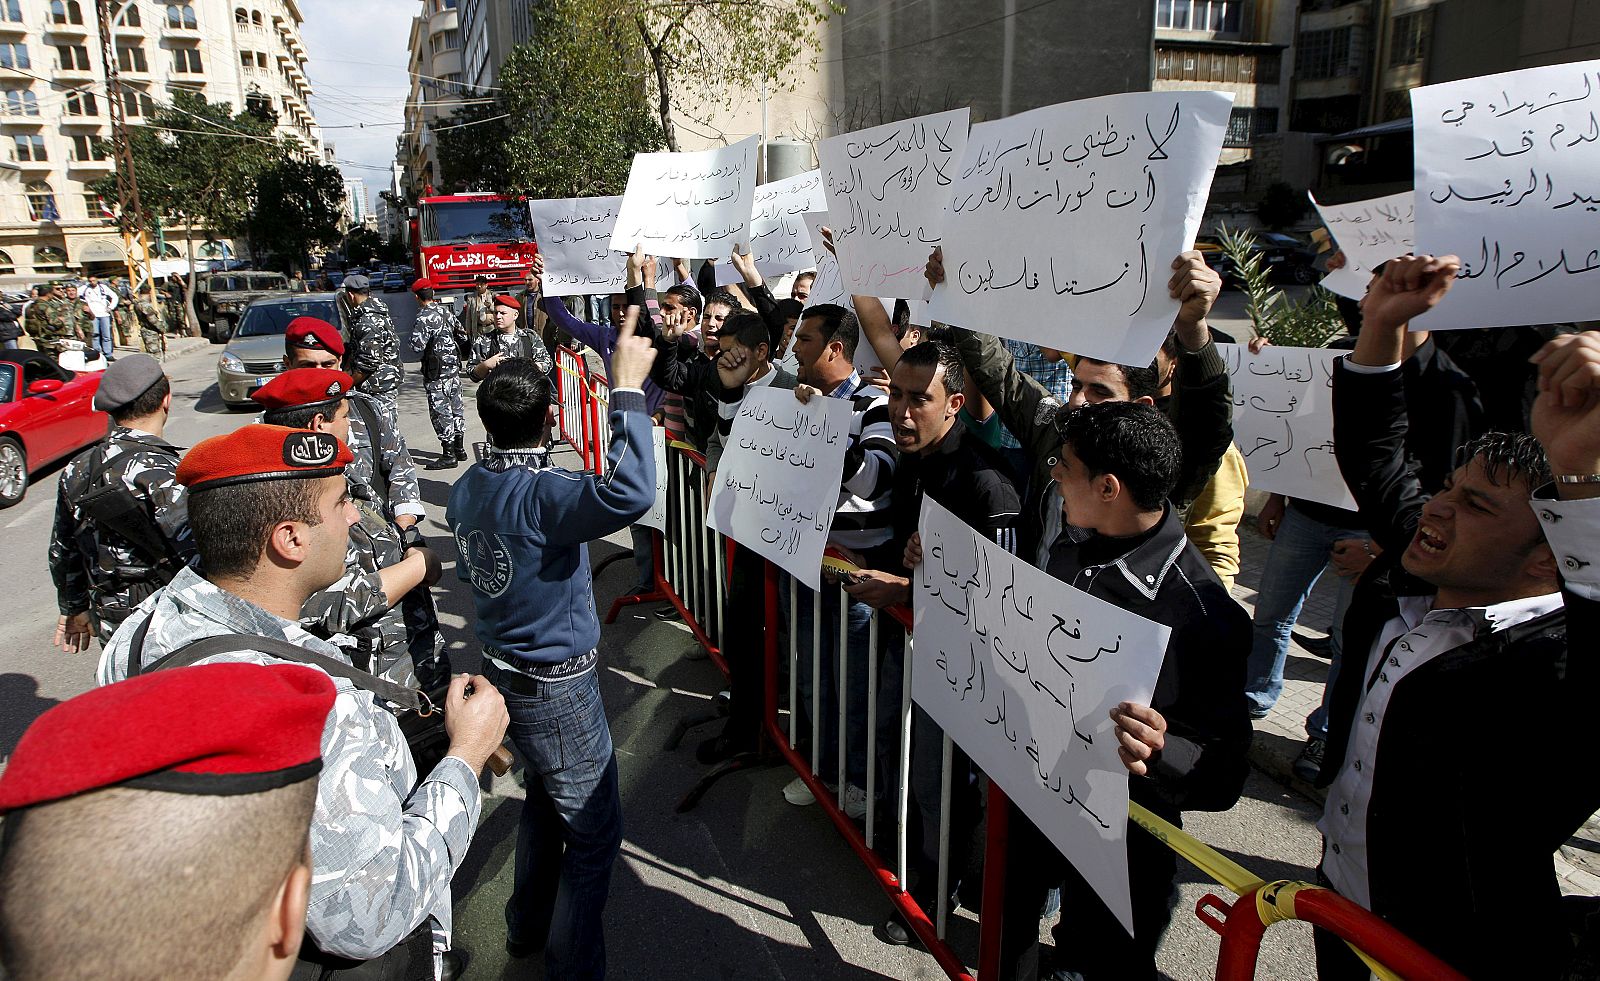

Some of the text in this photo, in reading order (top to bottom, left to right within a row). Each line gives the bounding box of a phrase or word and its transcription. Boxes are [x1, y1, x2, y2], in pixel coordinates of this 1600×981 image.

[1442, 101, 1475, 127] هي
[934, 121, 952, 152] لا
[1146, 102, 1179, 160] لا
[1465, 130, 1534, 161] قد
[933, 157, 952, 185] لا
[1107, 165, 1156, 212] أن
[486, 253, 520, 268] فوج
[958, 256, 1040, 295] فلسطين
[1047, 613, 1122, 679] نرفع
